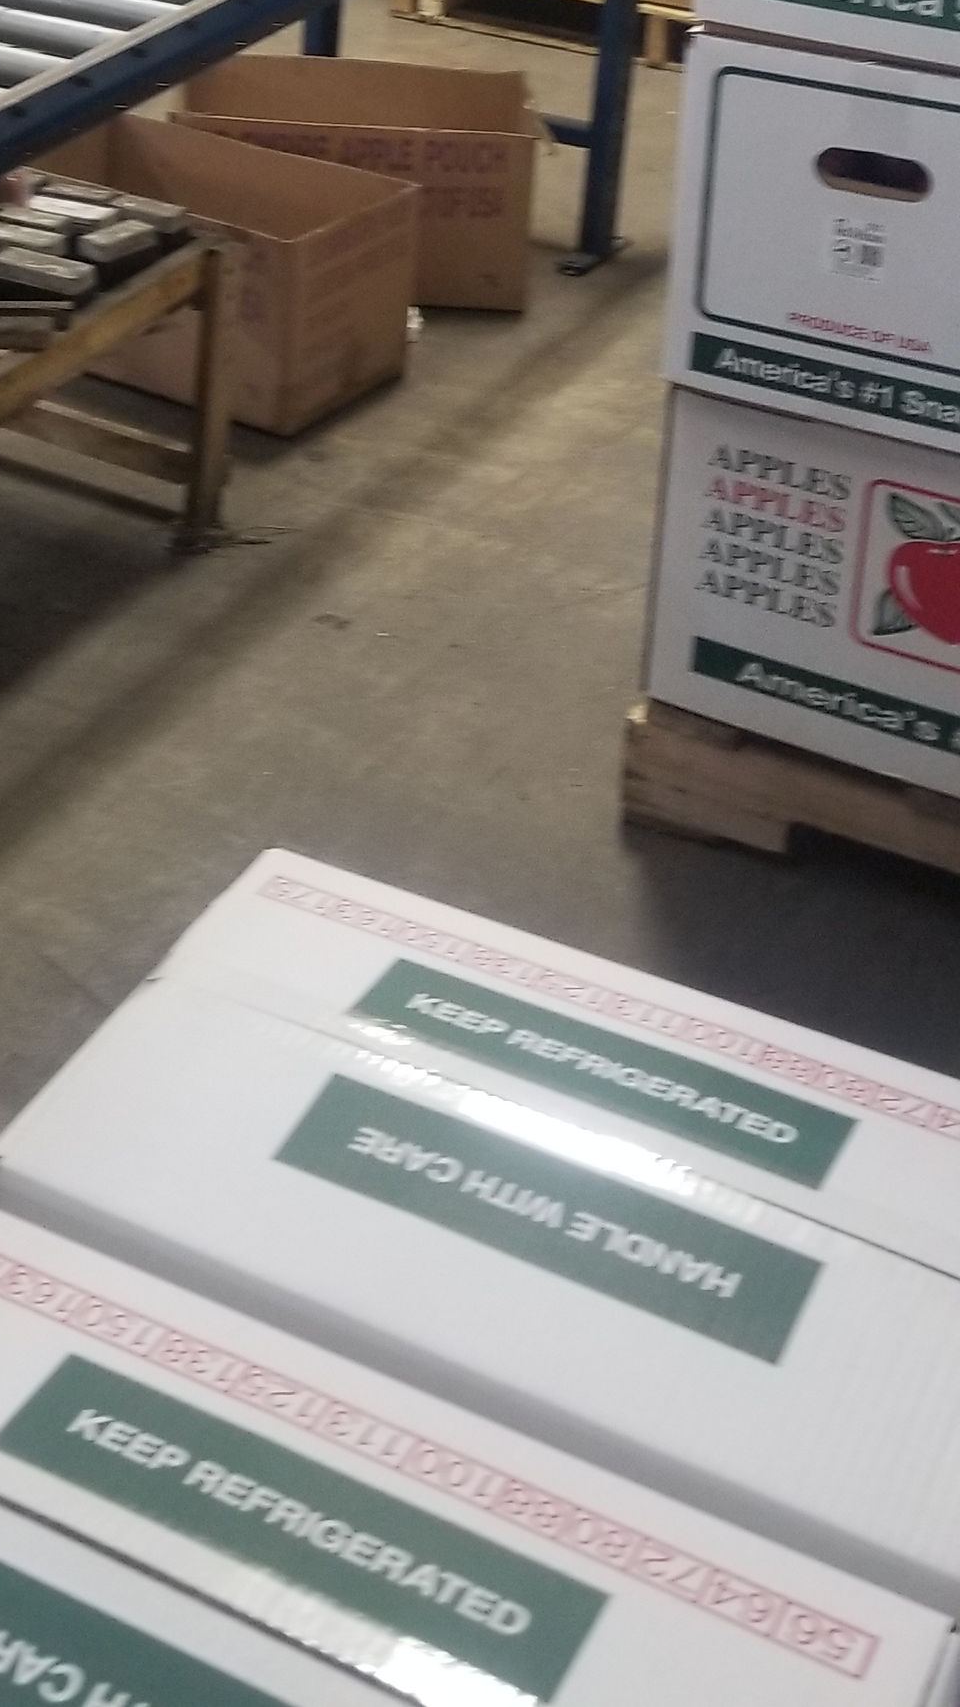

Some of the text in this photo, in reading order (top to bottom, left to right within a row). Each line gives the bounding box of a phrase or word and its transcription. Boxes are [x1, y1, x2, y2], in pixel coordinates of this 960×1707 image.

[715, 347, 857, 399] America's
[899, 390, 960, 424] Sna
[708, 444, 852, 500] APPLES
[704, 475, 846, 532] APPLES
[701, 506, 844, 564] APPLES
[697, 537, 840, 595] APPLES
[694, 568, 836, 627] APPLES
[736, 662, 942, 742] America's
[404, 992, 800, 1146] KEEP REFRIGERATED
[347, 1126, 743, 1299] HANDLE WITH CARE
[70, 1298, 161, 1354] 150
[151, 1333, 244, 1391] 138
[230, 1368, 325, 1427] 125
[316, 1404, 409, 1464] 113
[404, 1442, 505, 1507] 100
[66, 1408, 534, 1638] KEEP REFRIGERATED
[494, 1481, 568, 1535] 88
[560, 1510, 637, 1565] 80
[632, 1541, 708, 1597] 72
[702, 1571, 777, 1628] 64
[780, 1604, 858, 1664] 56
